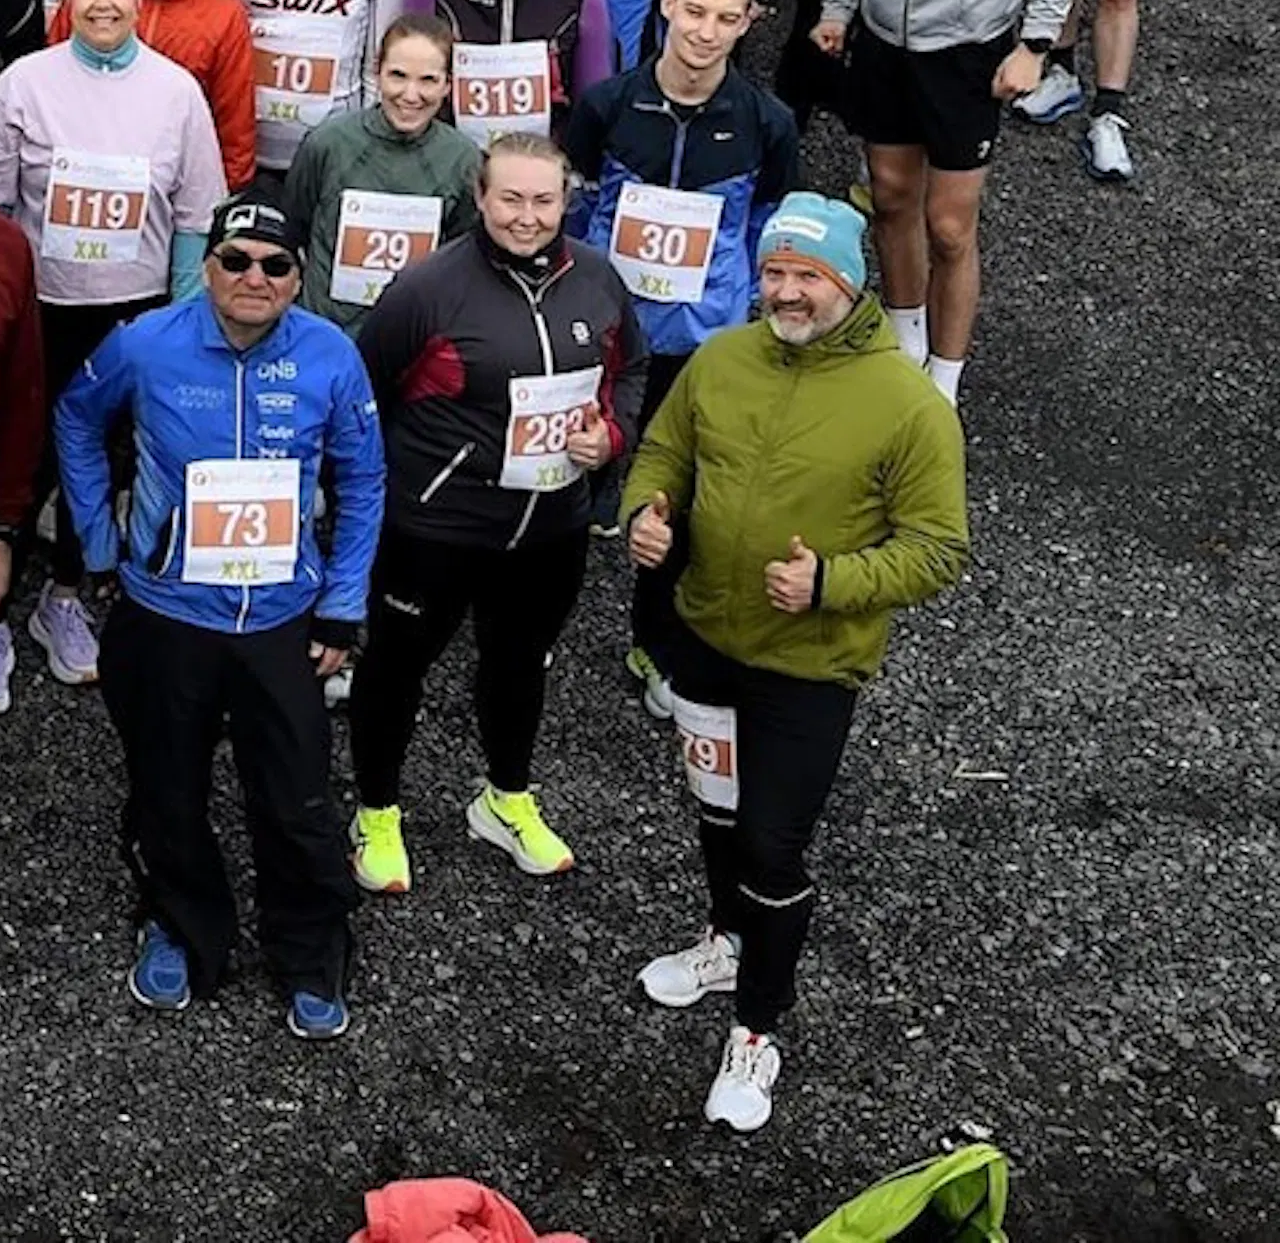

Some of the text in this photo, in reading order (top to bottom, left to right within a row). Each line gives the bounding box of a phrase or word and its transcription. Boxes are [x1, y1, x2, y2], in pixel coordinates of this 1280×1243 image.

[272, 54, 312, 92] 10
[468, 78, 534, 115] 319
[65, 189, 130, 229] 119
[73, 240, 108, 259] XXL
[368, 232, 410, 268] 29
[641, 226, 686, 265] 30
[641, 273, 673, 293] XXL
[217, 503, 269, 545] 73
